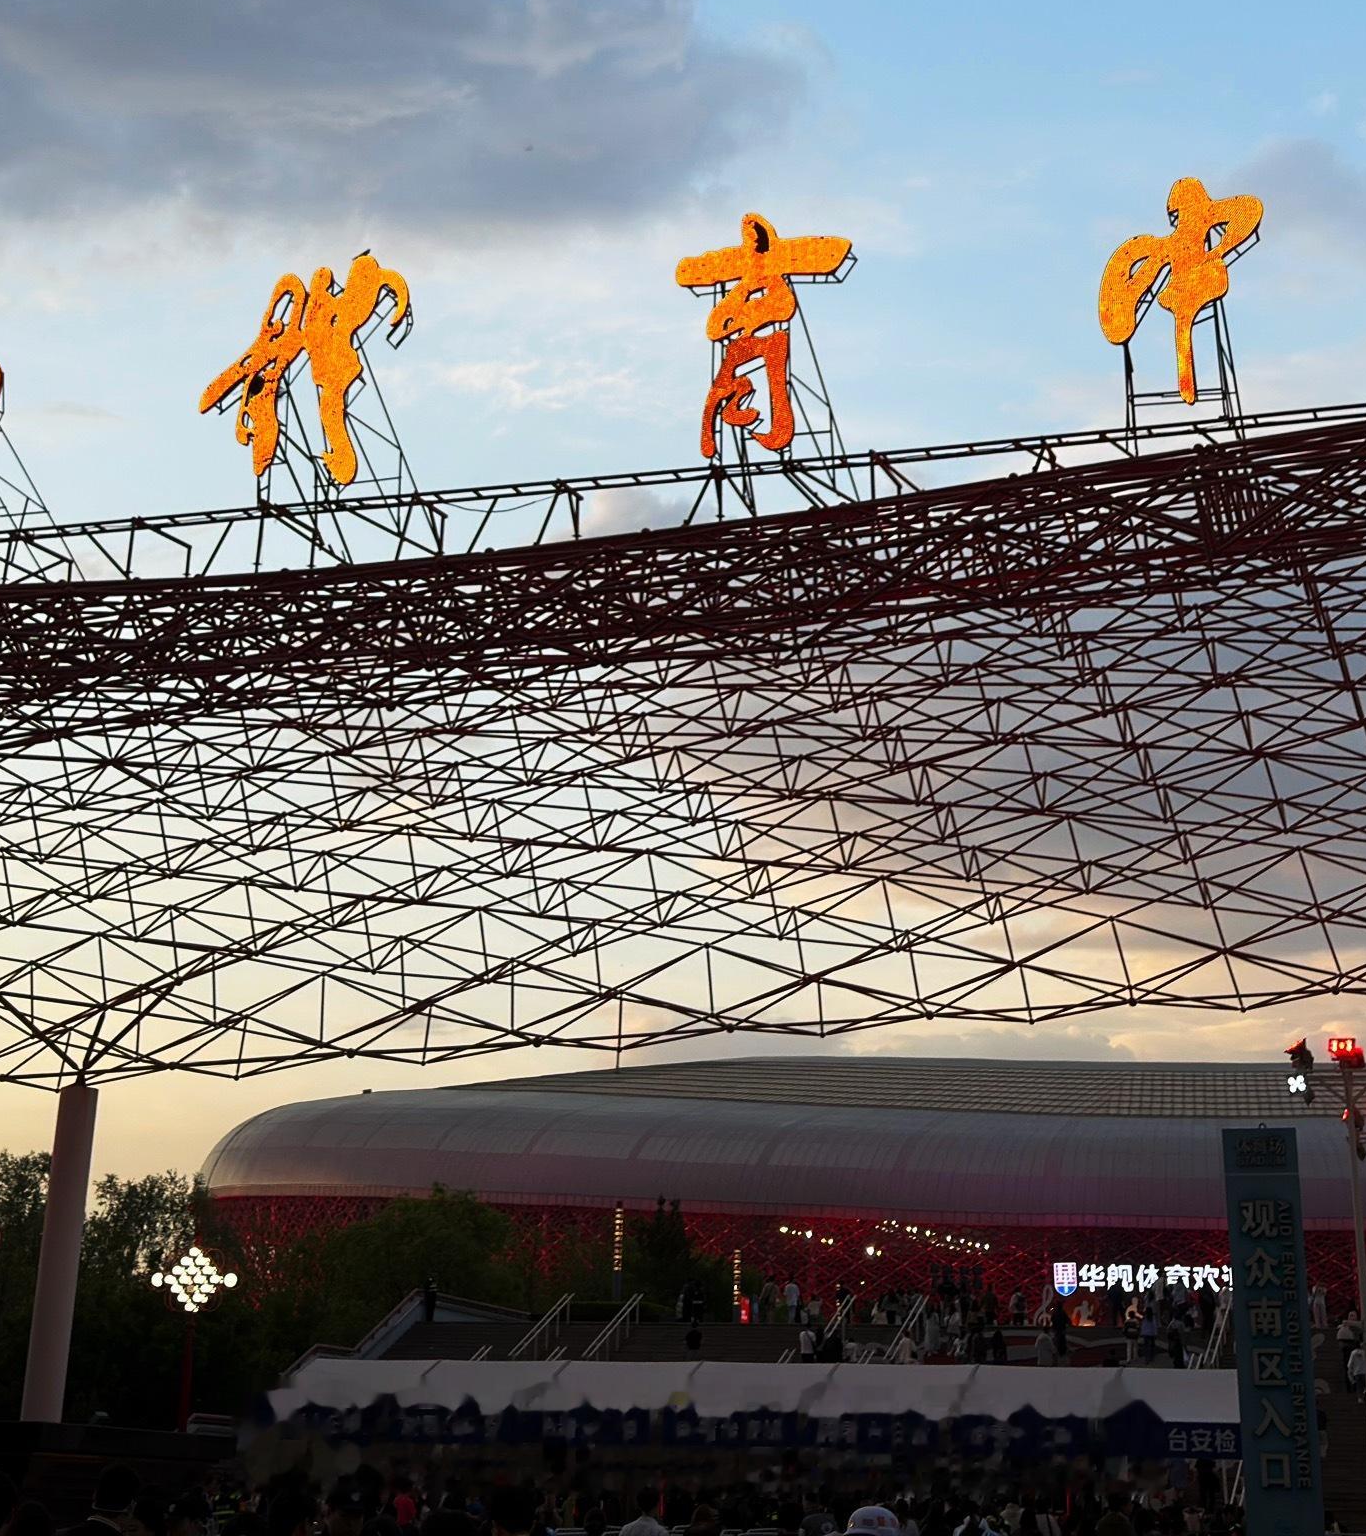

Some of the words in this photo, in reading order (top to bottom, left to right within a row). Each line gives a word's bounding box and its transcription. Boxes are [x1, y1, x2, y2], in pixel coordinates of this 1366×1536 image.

[1278, 1200, 1298, 1300] AUDIENCE
[1240, 1199, 1292, 1489] 观众南区入口
[1285, 1311, 1305, 1375] SOUTH
[1167, 1427, 1237, 1453] 台安检
[1290, 1383, 1313, 1490] ENTRANCE
